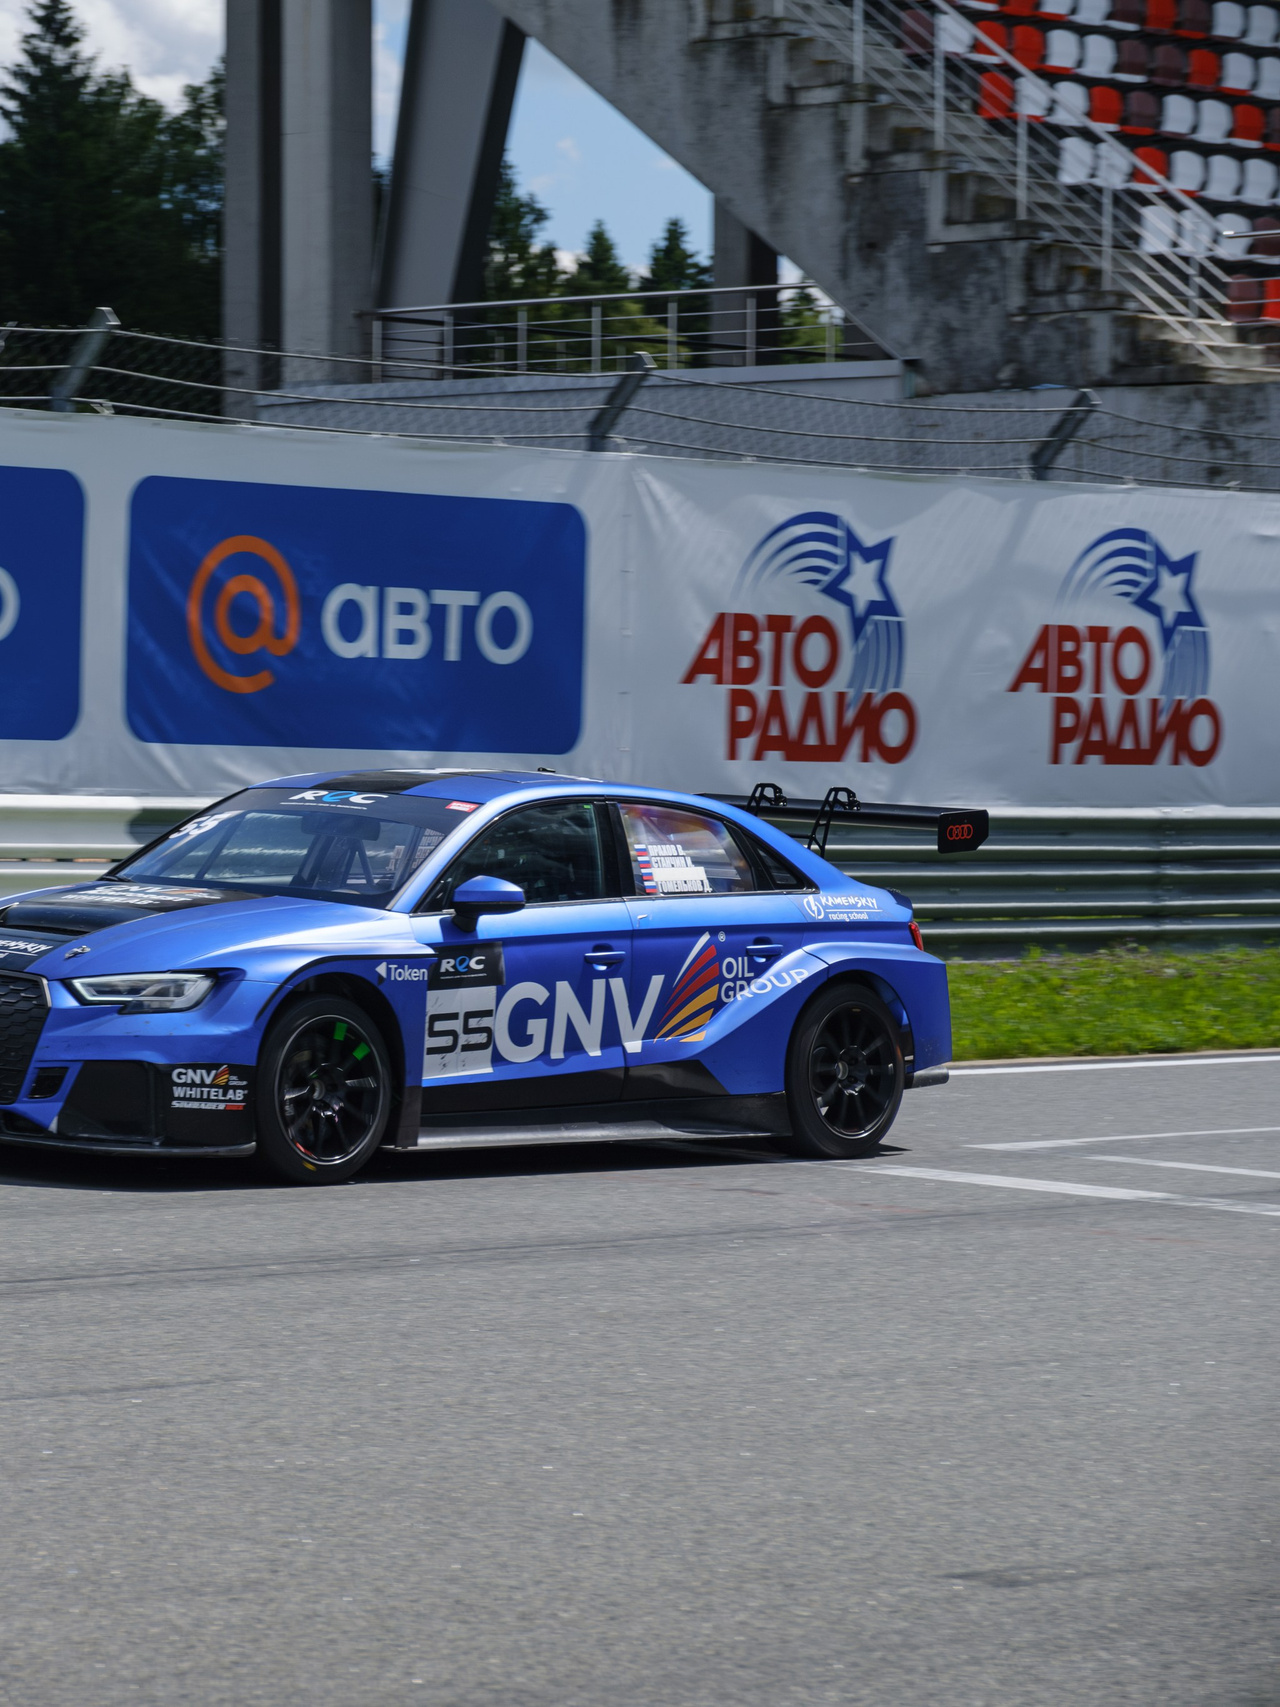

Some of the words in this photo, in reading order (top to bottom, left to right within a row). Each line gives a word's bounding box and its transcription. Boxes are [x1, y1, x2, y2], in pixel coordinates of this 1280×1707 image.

[678, 612, 841, 689] АВТО
[1006, 624, 1153, 696] АВТО
[723, 689, 918, 765] РАДИО
[1047, 696, 1225, 768] РАДИО
[820, 895, 878, 909] KAMENSKIY
[828, 911, 850, 922] racing
[848, 911, 869, 920] school
[388, 965, 428, 981] Token
[721, 968, 809, 1003] GROUP
[722, 957, 754, 979] OIL
[426, 1009, 494, 1055] 55
[494, 974, 665, 1063] GNV
[171, 1068, 217, 1085] GNV
